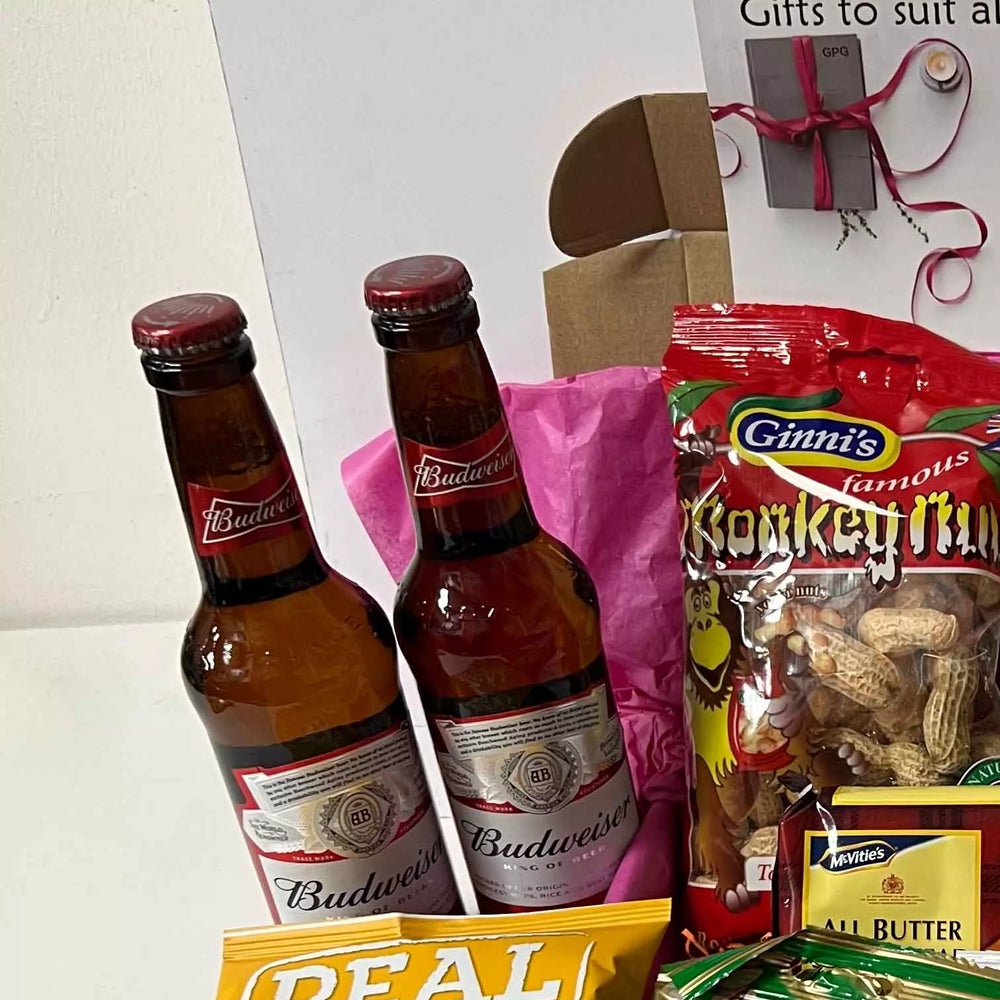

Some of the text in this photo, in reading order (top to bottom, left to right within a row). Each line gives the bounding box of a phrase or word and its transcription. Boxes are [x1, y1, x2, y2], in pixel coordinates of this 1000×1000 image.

[740, 0, 825, 27] Gifts
[838, 0, 878, 26] to
[894, 0, 956, 25] suit
[822, 46, 850, 58] GPG
[744, 419, 878, 458] Ginni's
[841, 450, 970, 495] famous
[202, 488, 299, 533] Budweis
[680, 491, 902, 590] Monkey
[461, 795, 632, 860] Budweiser
[829, 846, 886, 869] McVitie's
[873, 918, 962, 941] BUTTER
